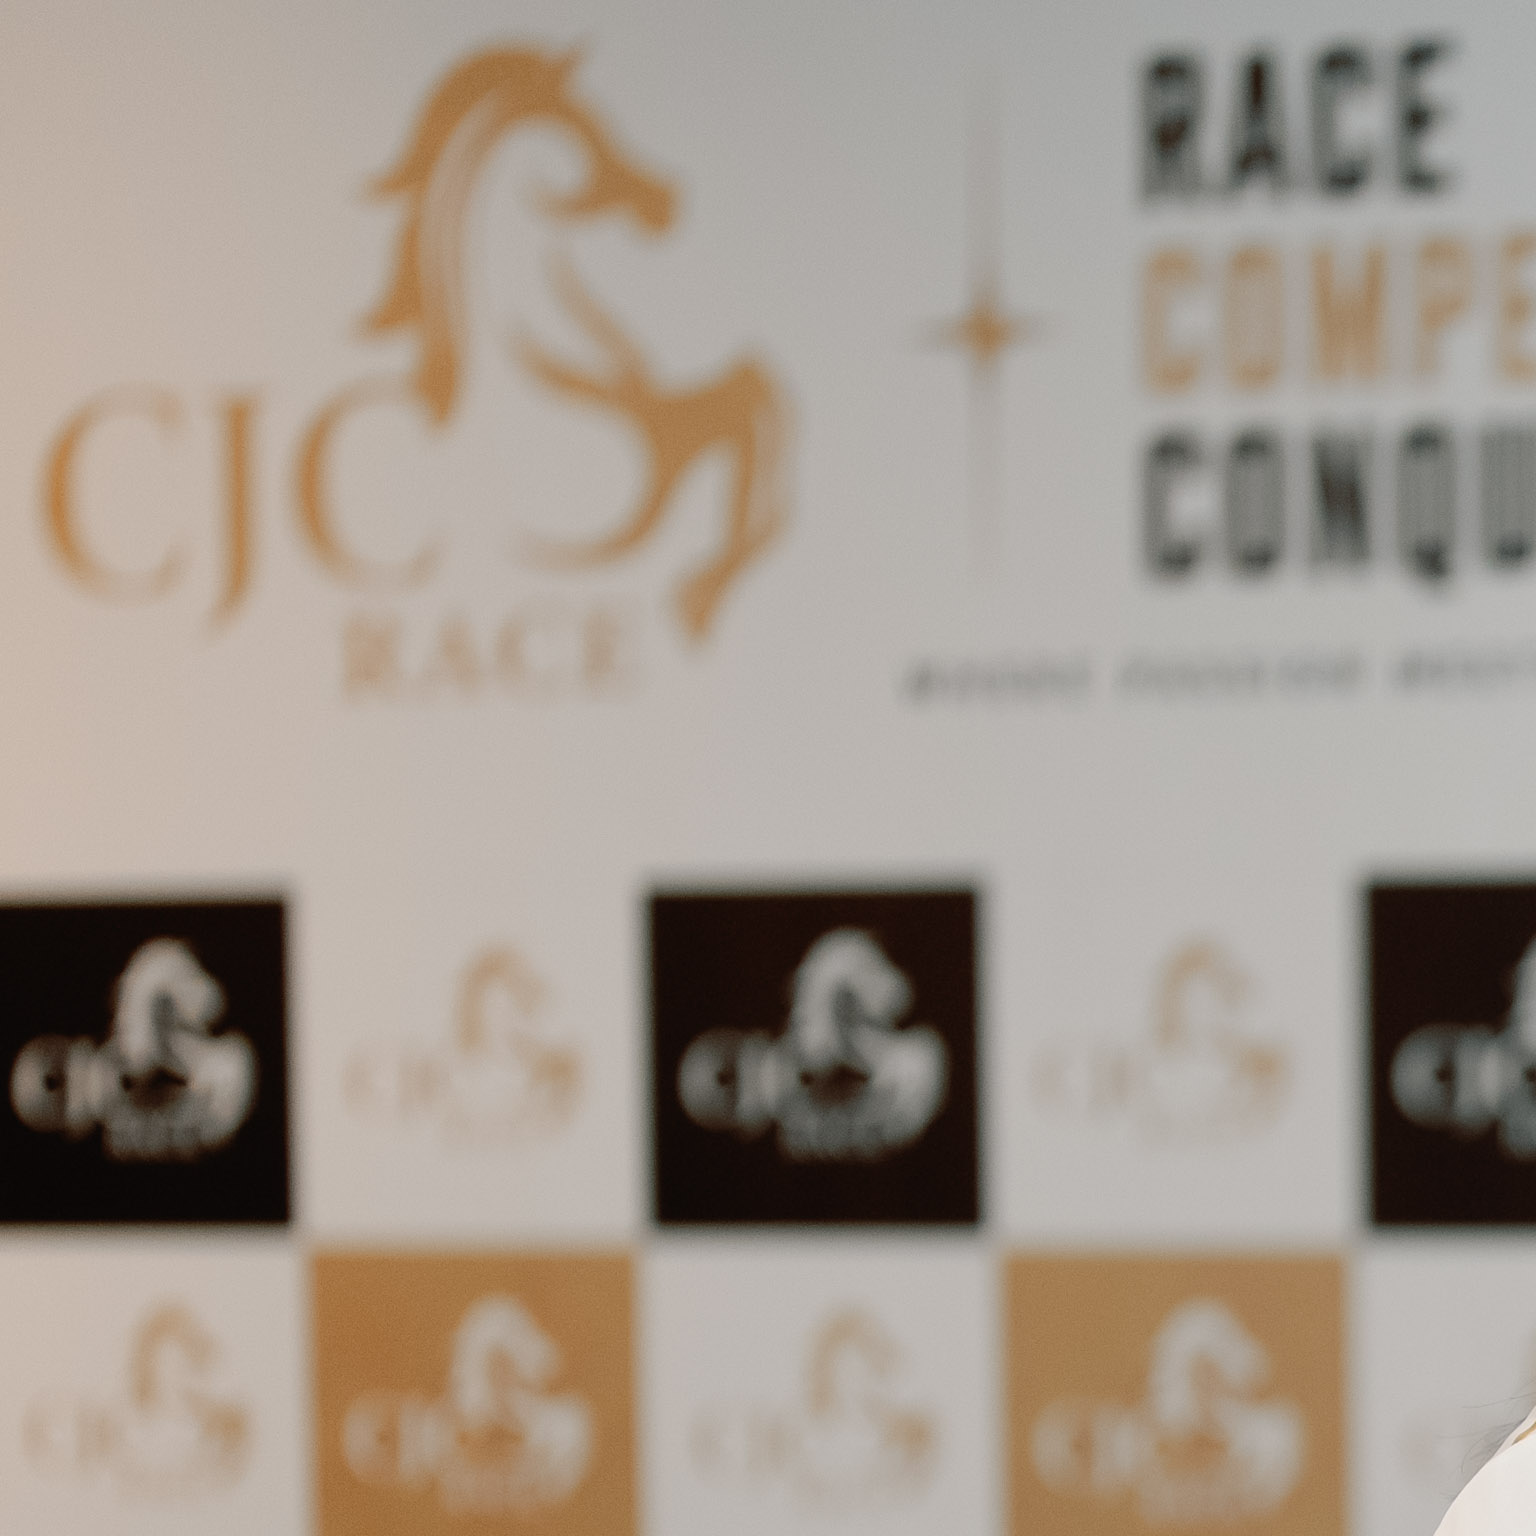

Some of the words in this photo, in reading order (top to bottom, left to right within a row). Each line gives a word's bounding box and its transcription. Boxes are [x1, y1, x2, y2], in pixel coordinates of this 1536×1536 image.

[1140, 34, 1458, 204] RACE
[38, 376, 448, 640] CJC
[341, 606, 634, 702] RACE
